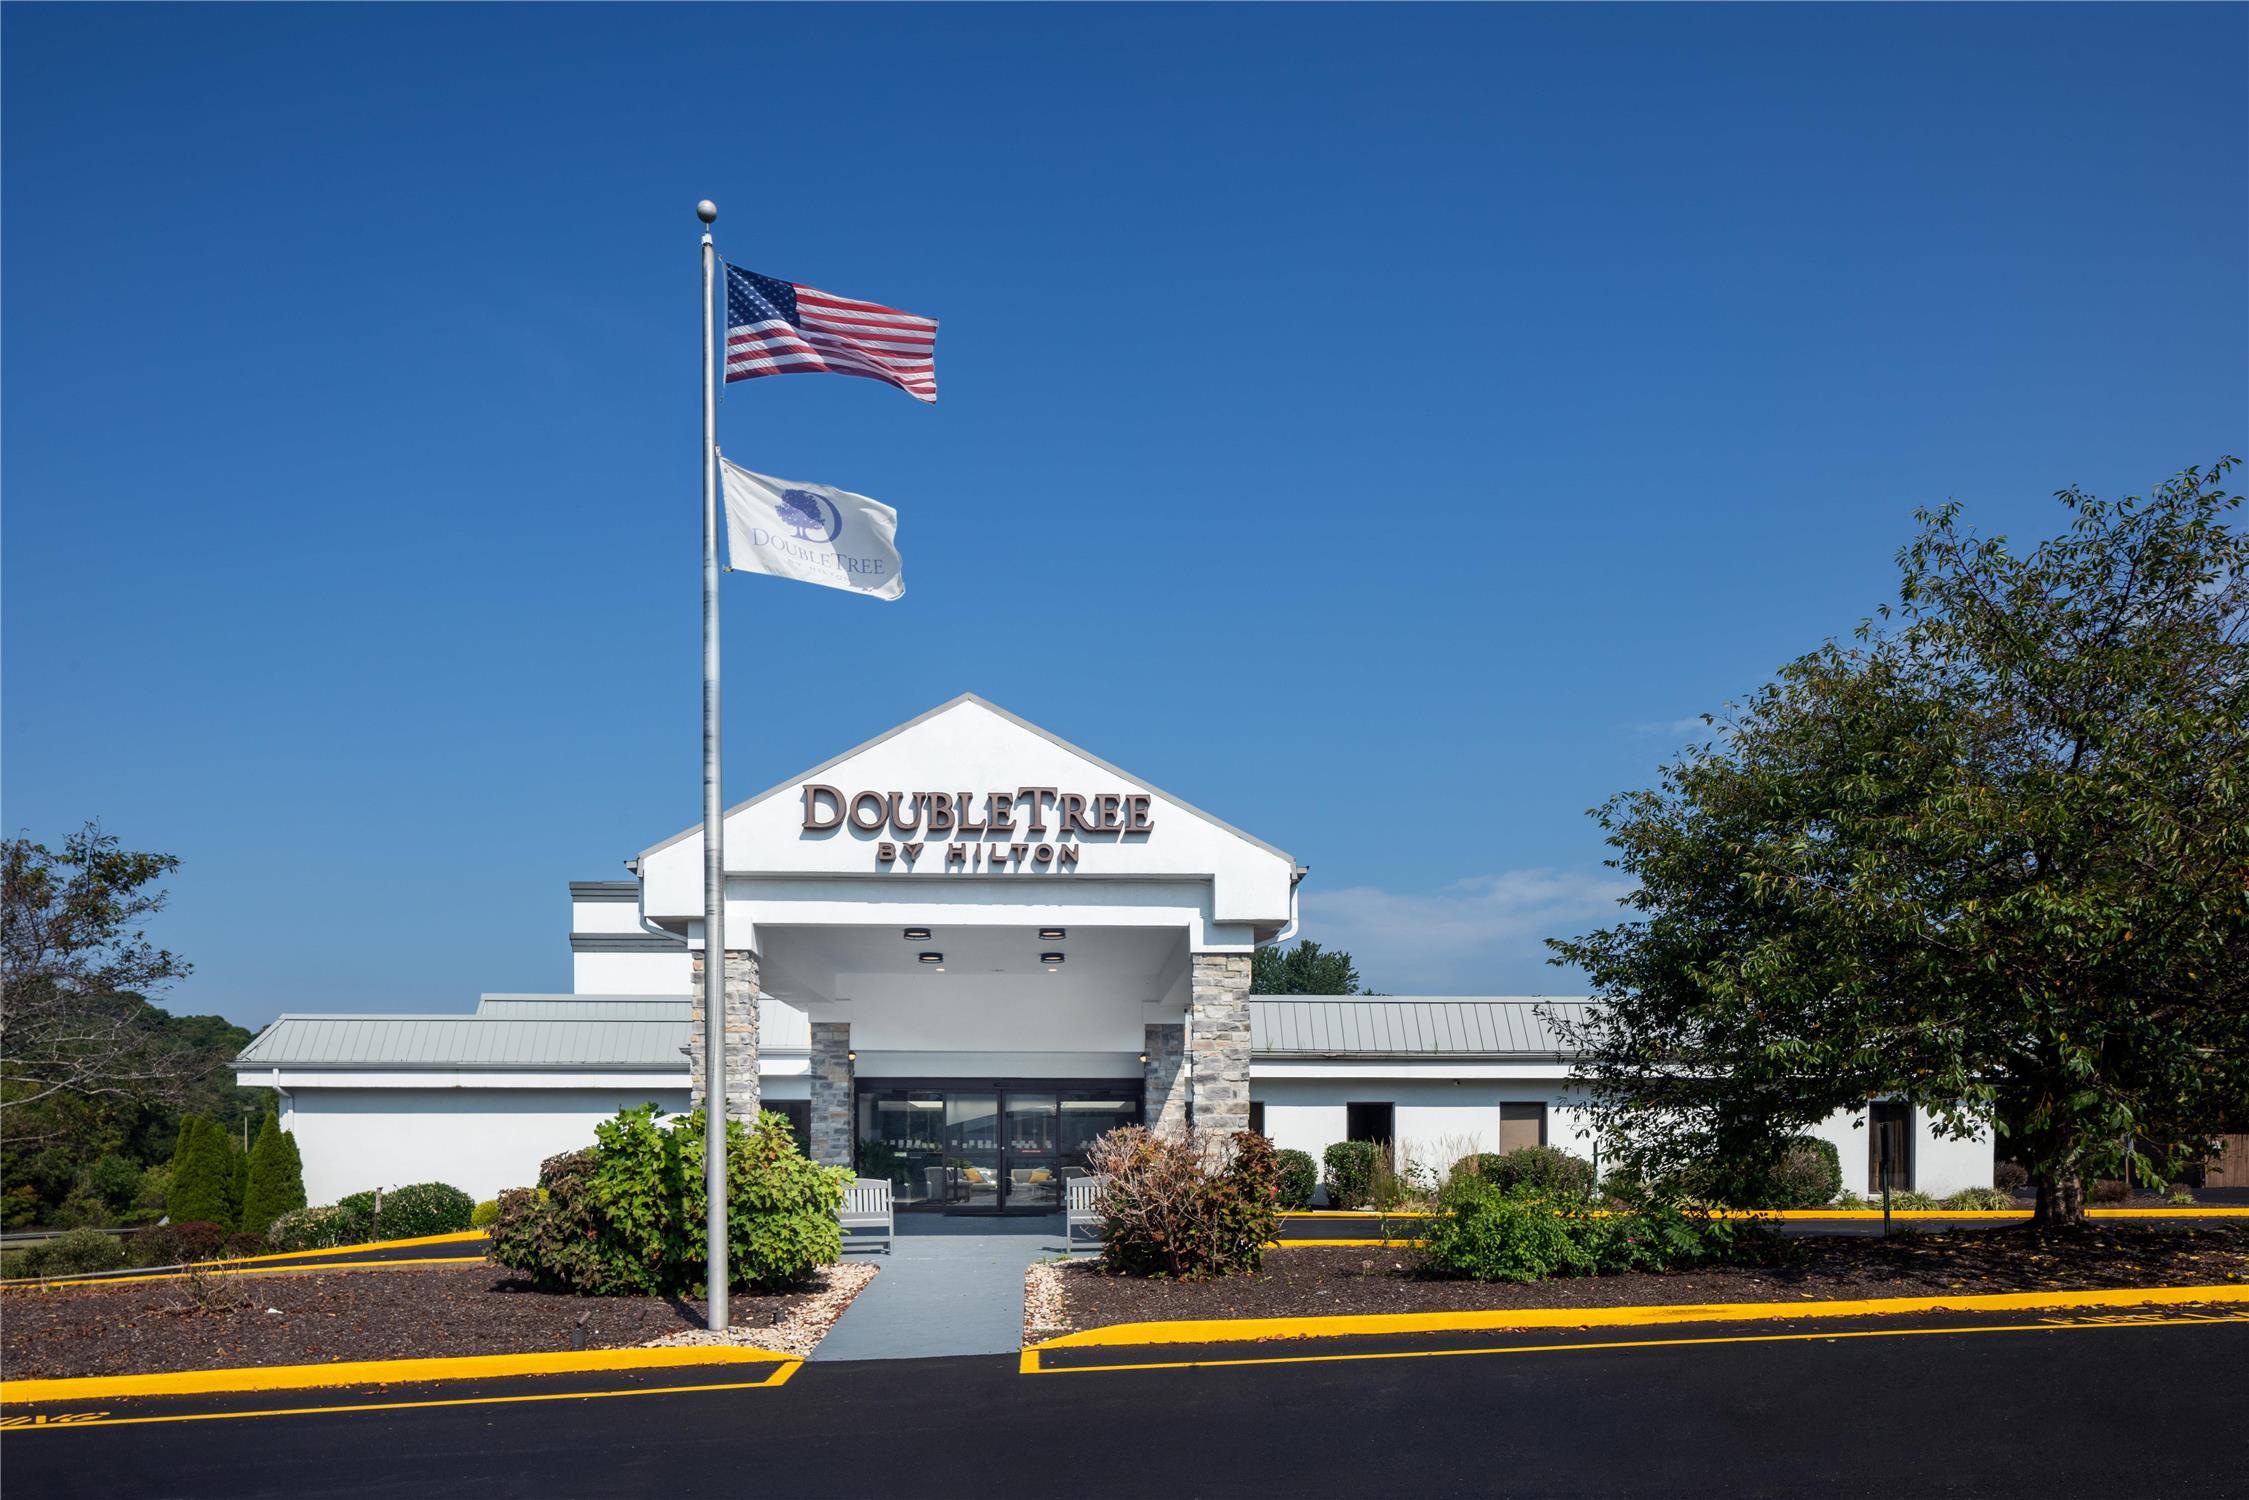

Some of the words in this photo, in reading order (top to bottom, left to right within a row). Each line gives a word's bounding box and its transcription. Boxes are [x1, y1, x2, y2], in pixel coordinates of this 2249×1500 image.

[752, 528, 885, 575] DOUBLETREE
[802, 784, 1154, 833] DOUBLETREE
[877, 842, 923, 862] BY
[948, 843, 1079, 864] HILTON
